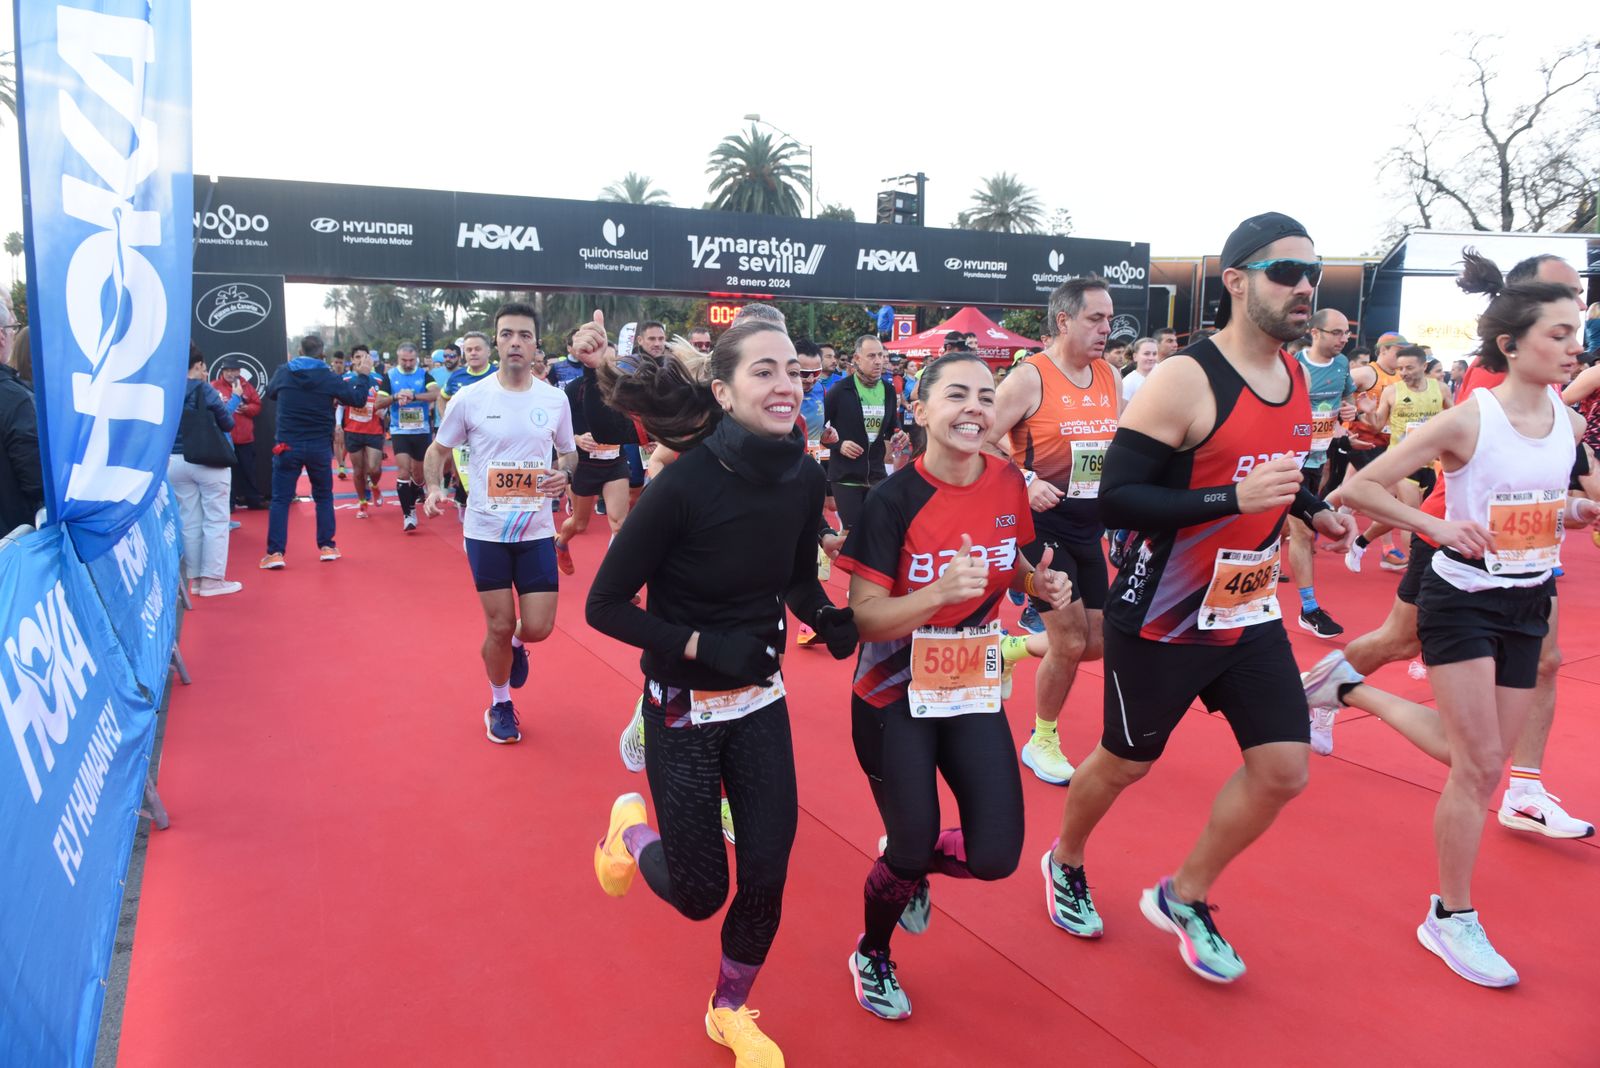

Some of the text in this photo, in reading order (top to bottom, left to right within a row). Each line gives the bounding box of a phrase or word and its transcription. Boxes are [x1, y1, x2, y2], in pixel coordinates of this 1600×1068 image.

[342, 220, 413, 235] HYUNDAI
[192, 238, 234, 246] NTAMIENTO
[342, 235, 413, 246] Hyundauto Motor
[457, 222, 543, 252] HOKA
[57, 5, 167, 503] HOKA
[713, 236, 806, 258] maratón
[584, 263, 643, 272] Healthcare Partner
[738, 253, 811, 275] sevilla
[856, 249, 920, 273] HOKA
[963, 260, 1008, 271] HYUNDAI
[726, 276, 791, 288] 28 enero 2024
[864, 418, 881, 428] 206
[1061, 425, 1118, 436] COSLAD
[1081, 454, 1104, 472] 769
[496, 473, 532, 488] 3874
[1203, 492, 1227, 503] GORE
[1502, 510, 1552, 536] 4581
[1224, 565, 1271, 595] 4688
[924, 645, 980, 674] 5804
[0, 580, 97, 804] HOKA
[53, 696, 123, 887] FLY HUMAN FLY
